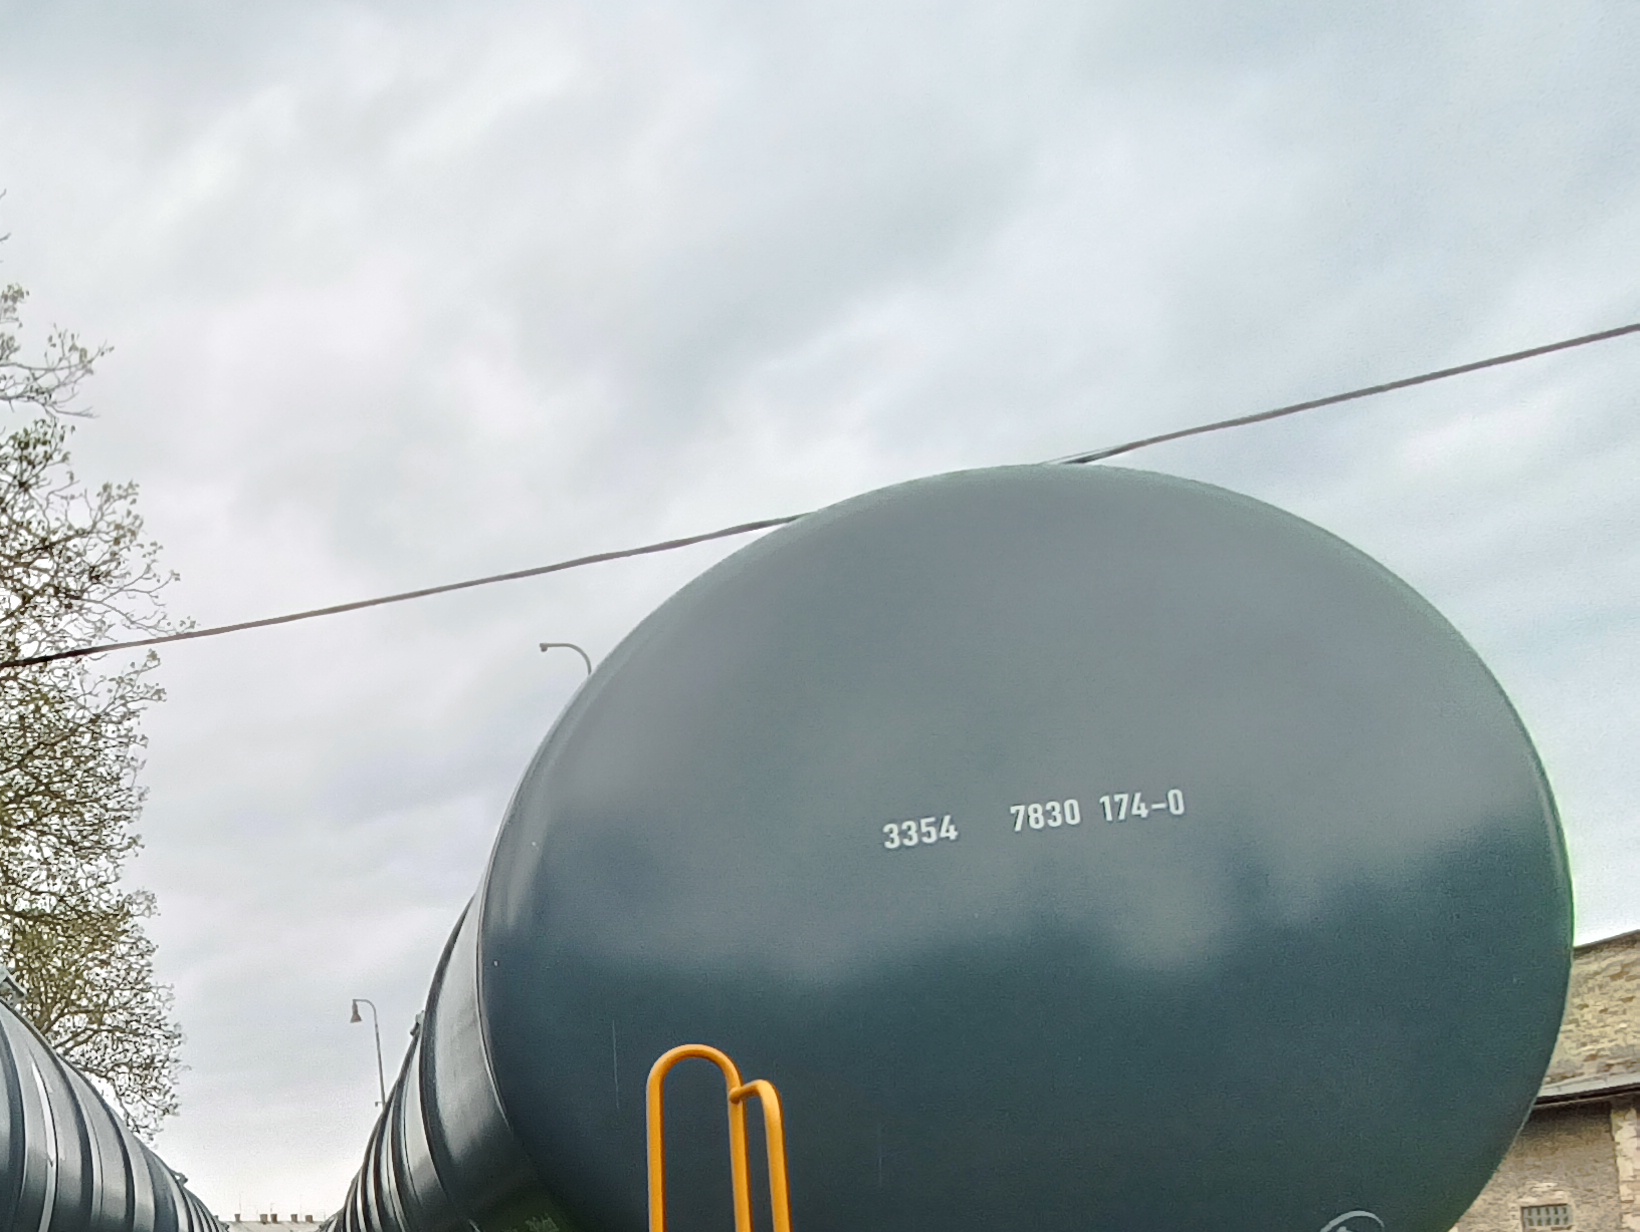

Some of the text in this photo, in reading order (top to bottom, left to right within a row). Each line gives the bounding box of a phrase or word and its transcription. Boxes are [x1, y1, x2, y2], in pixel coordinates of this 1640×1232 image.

[883, 788, 1185, 850] 3354 7830 174-0
